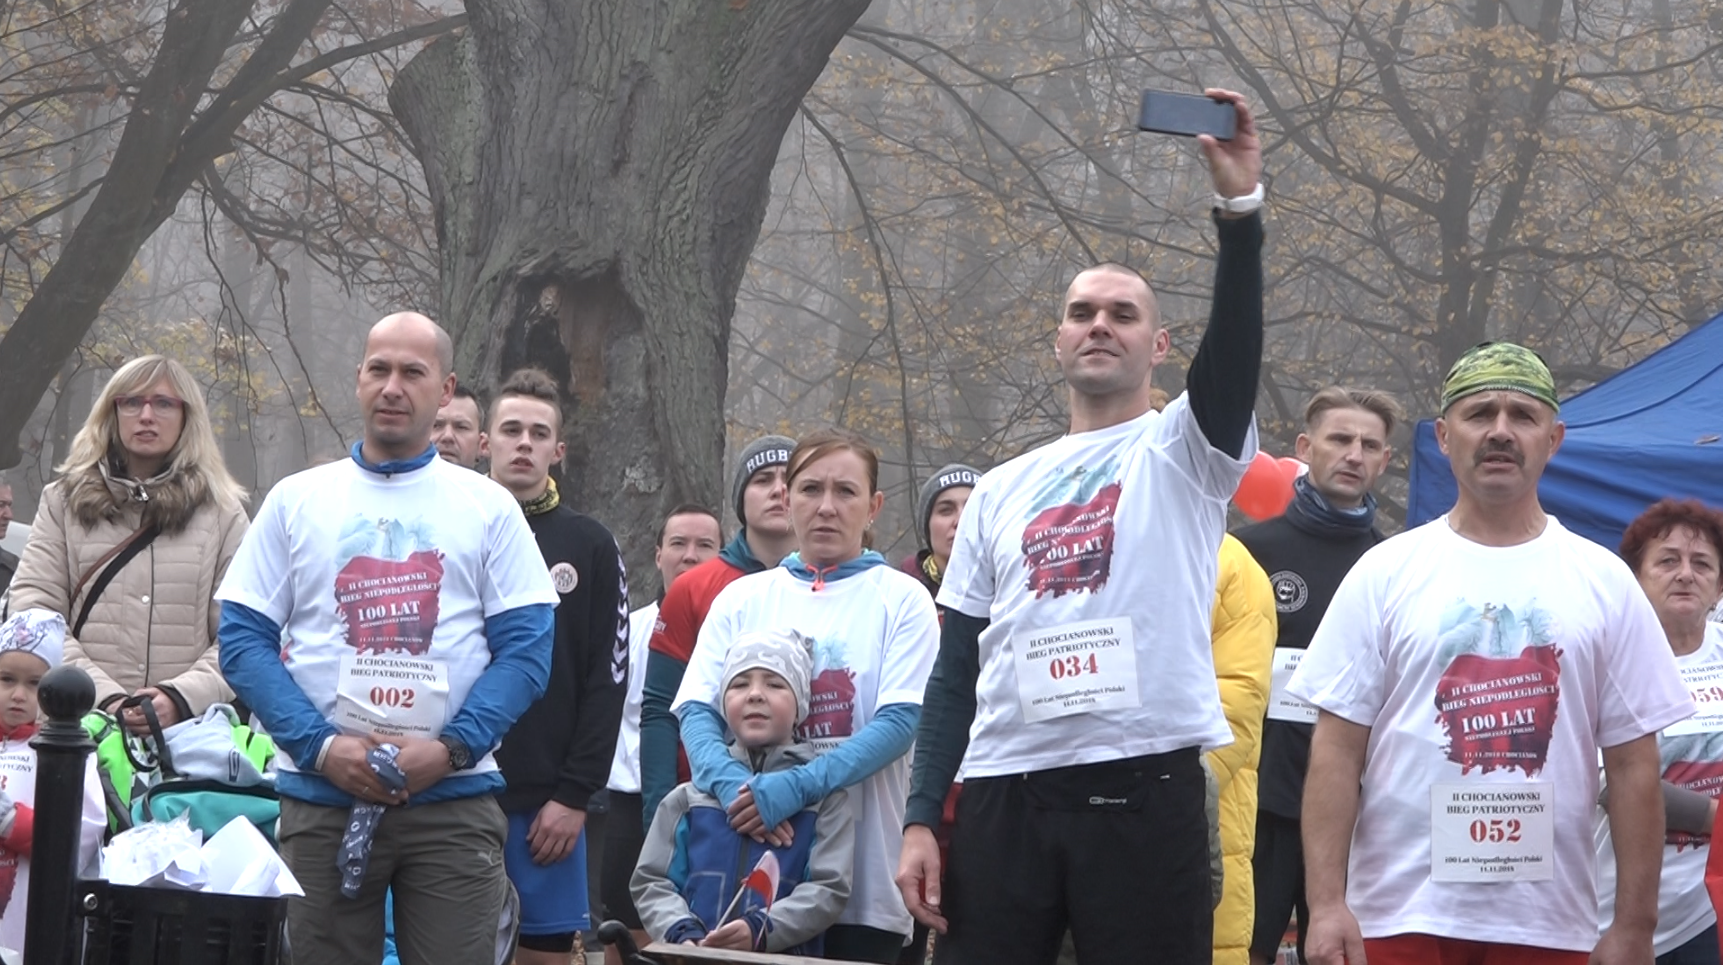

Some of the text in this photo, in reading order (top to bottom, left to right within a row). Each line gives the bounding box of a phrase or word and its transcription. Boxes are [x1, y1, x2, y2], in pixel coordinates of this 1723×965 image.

[746, 449, 792, 474] RUGB
[1073, 535, 1104, 555] LAT
[348, 572, 427, 591] II CHOCIANOWSKI
[340, 593, 362, 603] BIEG
[358, 600, 420, 621] 100 LAT
[1030, 627, 1114, 648] II CHOCIANOWSKI
[1026, 638, 1121, 661] BIEG PATRIOTYCZNY
[350, 668, 438, 683] BIEG PATRIOTYCZNY
[356, 658, 434, 672] II CHOCIANOWSKI
[1049, 652, 1099, 680] 034
[1451, 672, 1542, 697] II CHOCIANOWSKI
[369, 686, 415, 708] 002
[1442, 699, 1467, 712] BIEG
[1462, 707, 1536, 734] 100 LAT
[1452, 792, 1541, 802] II CHOCIANOWSKI
[1446, 804, 1545, 814] BIEG PATRIOTYCZNY
[1469, 819, 1522, 843] 052
